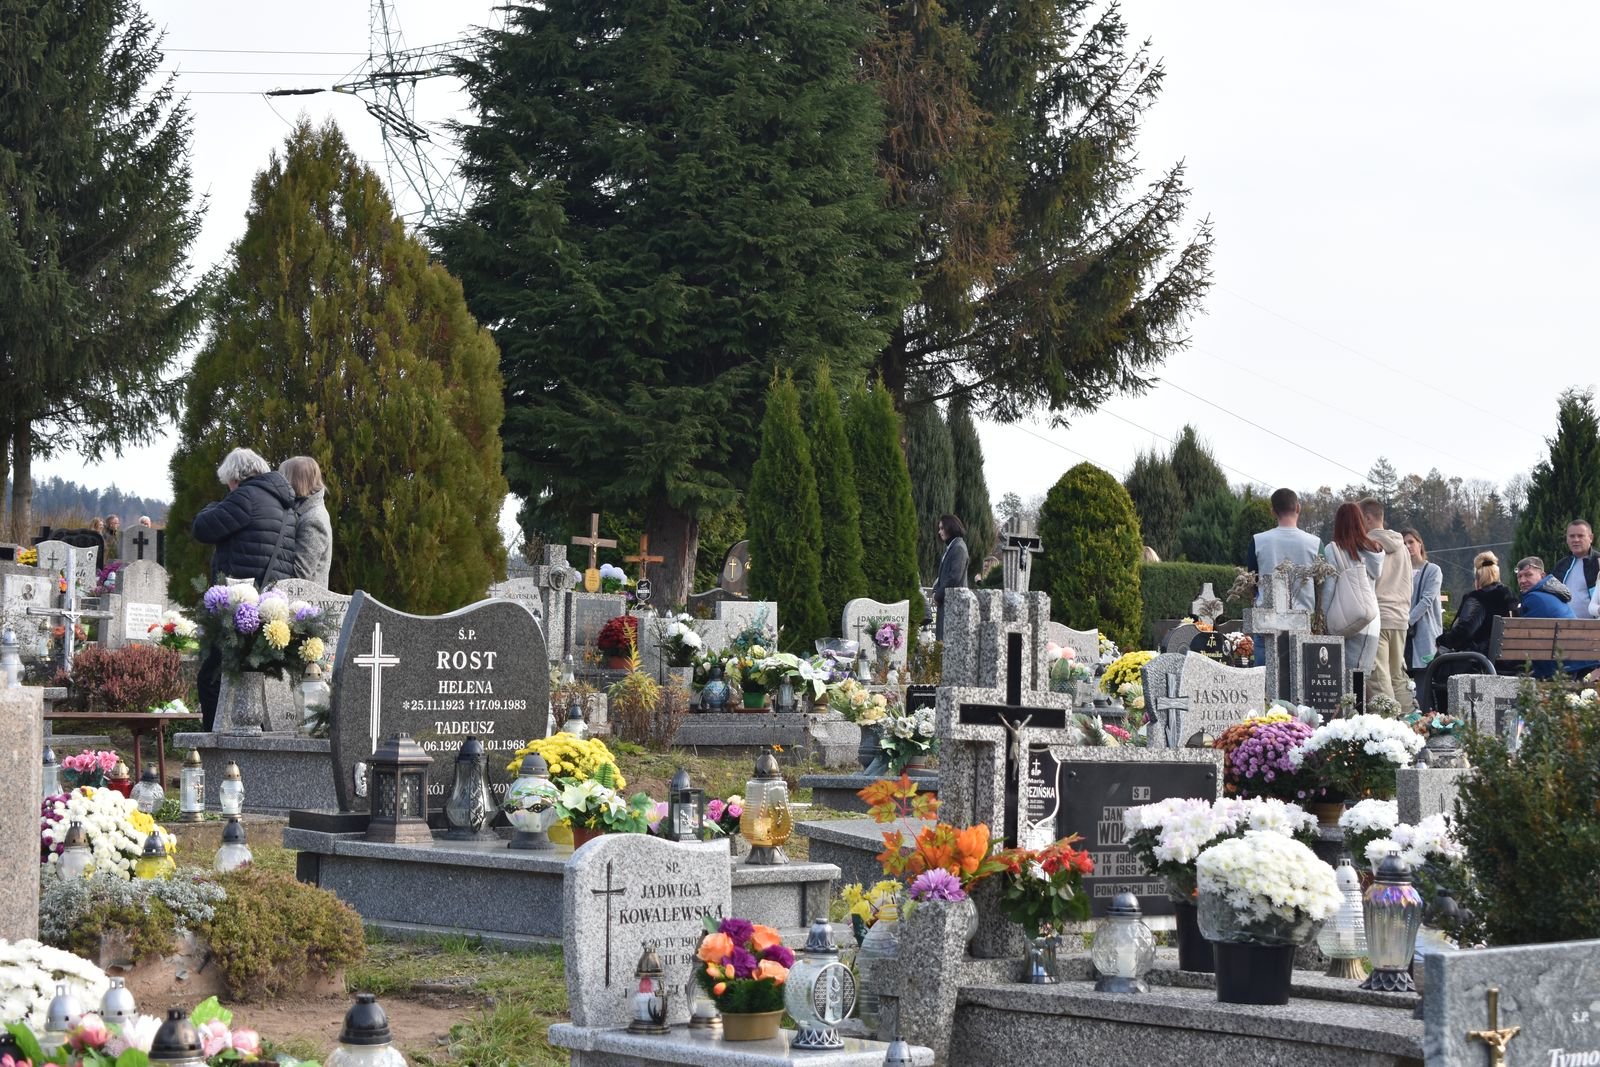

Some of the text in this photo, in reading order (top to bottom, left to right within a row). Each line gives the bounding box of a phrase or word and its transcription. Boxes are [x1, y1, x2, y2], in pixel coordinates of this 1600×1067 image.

[436, 650, 497, 670] ROST
[438, 680, 494, 694] HELENA
[1193, 689, 1249, 704] JASNOS
[1201, 710, 1242, 721] JULIAN
[435, 721, 495, 734] TADEUSZ
[1104, 808, 1123, 821] JAN
[1103, 853, 1112, 864] IX
[1116, 853, 1137, 864] 1906
[1116, 865, 1137, 875] 1969
[641, 883, 701, 899] JADWIGA
[619, 904, 723, 924] KOWALEWSKA
[682, 937, 700, 948] 190
[664, 954, 676, 965] III
[1547, 1048, 1600, 1067] Tymo
